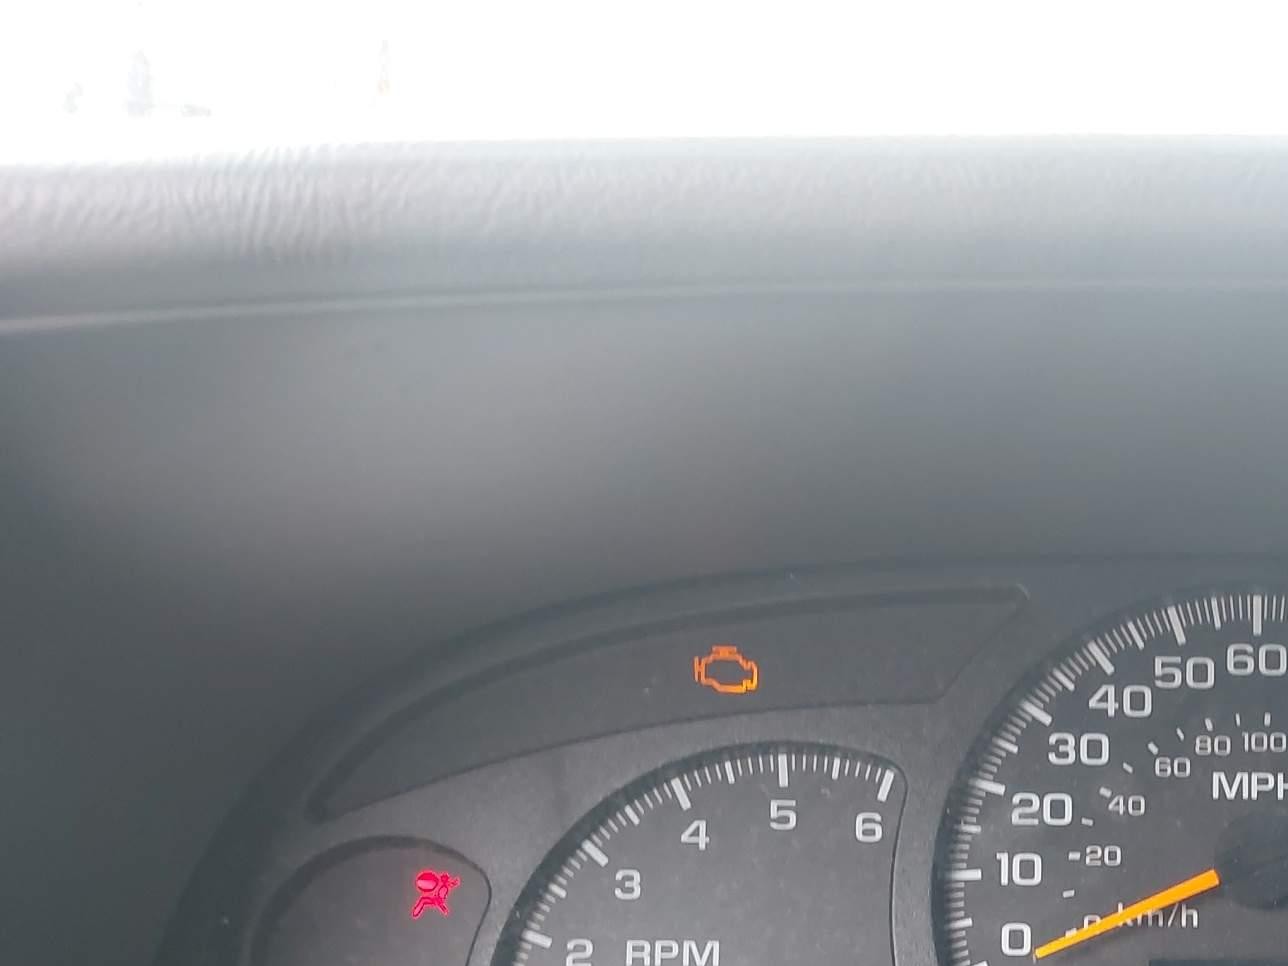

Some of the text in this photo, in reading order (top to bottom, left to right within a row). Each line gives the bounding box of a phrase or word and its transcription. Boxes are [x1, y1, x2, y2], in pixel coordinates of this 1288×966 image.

[1155, 657, 1214, 688] 50
[1227, 644, 1286, 675] 60
[1089, 685, 1151, 716] 40
[1049, 733, 1109, 765] 30
[1196, 736, 1230, 754] 80
[1244, 733, 1286, 751] 100
[1155, 758, 1190, 776] 60
[771, 800, 796, 829] 5
[1012, 793, 1072, 825] 20
[1109, 796, 1145, 814] 40
[681, 821, 709, 850] 4
[856, 813, 882, 842] 6
[997, 853, 1041, 885] 10
[1086, 846, 1121, 865] 20
[615, 870, 640, 899] 3
[626, 940, 719, 966] RPM
[1002, 923, 1031, 955] 0
